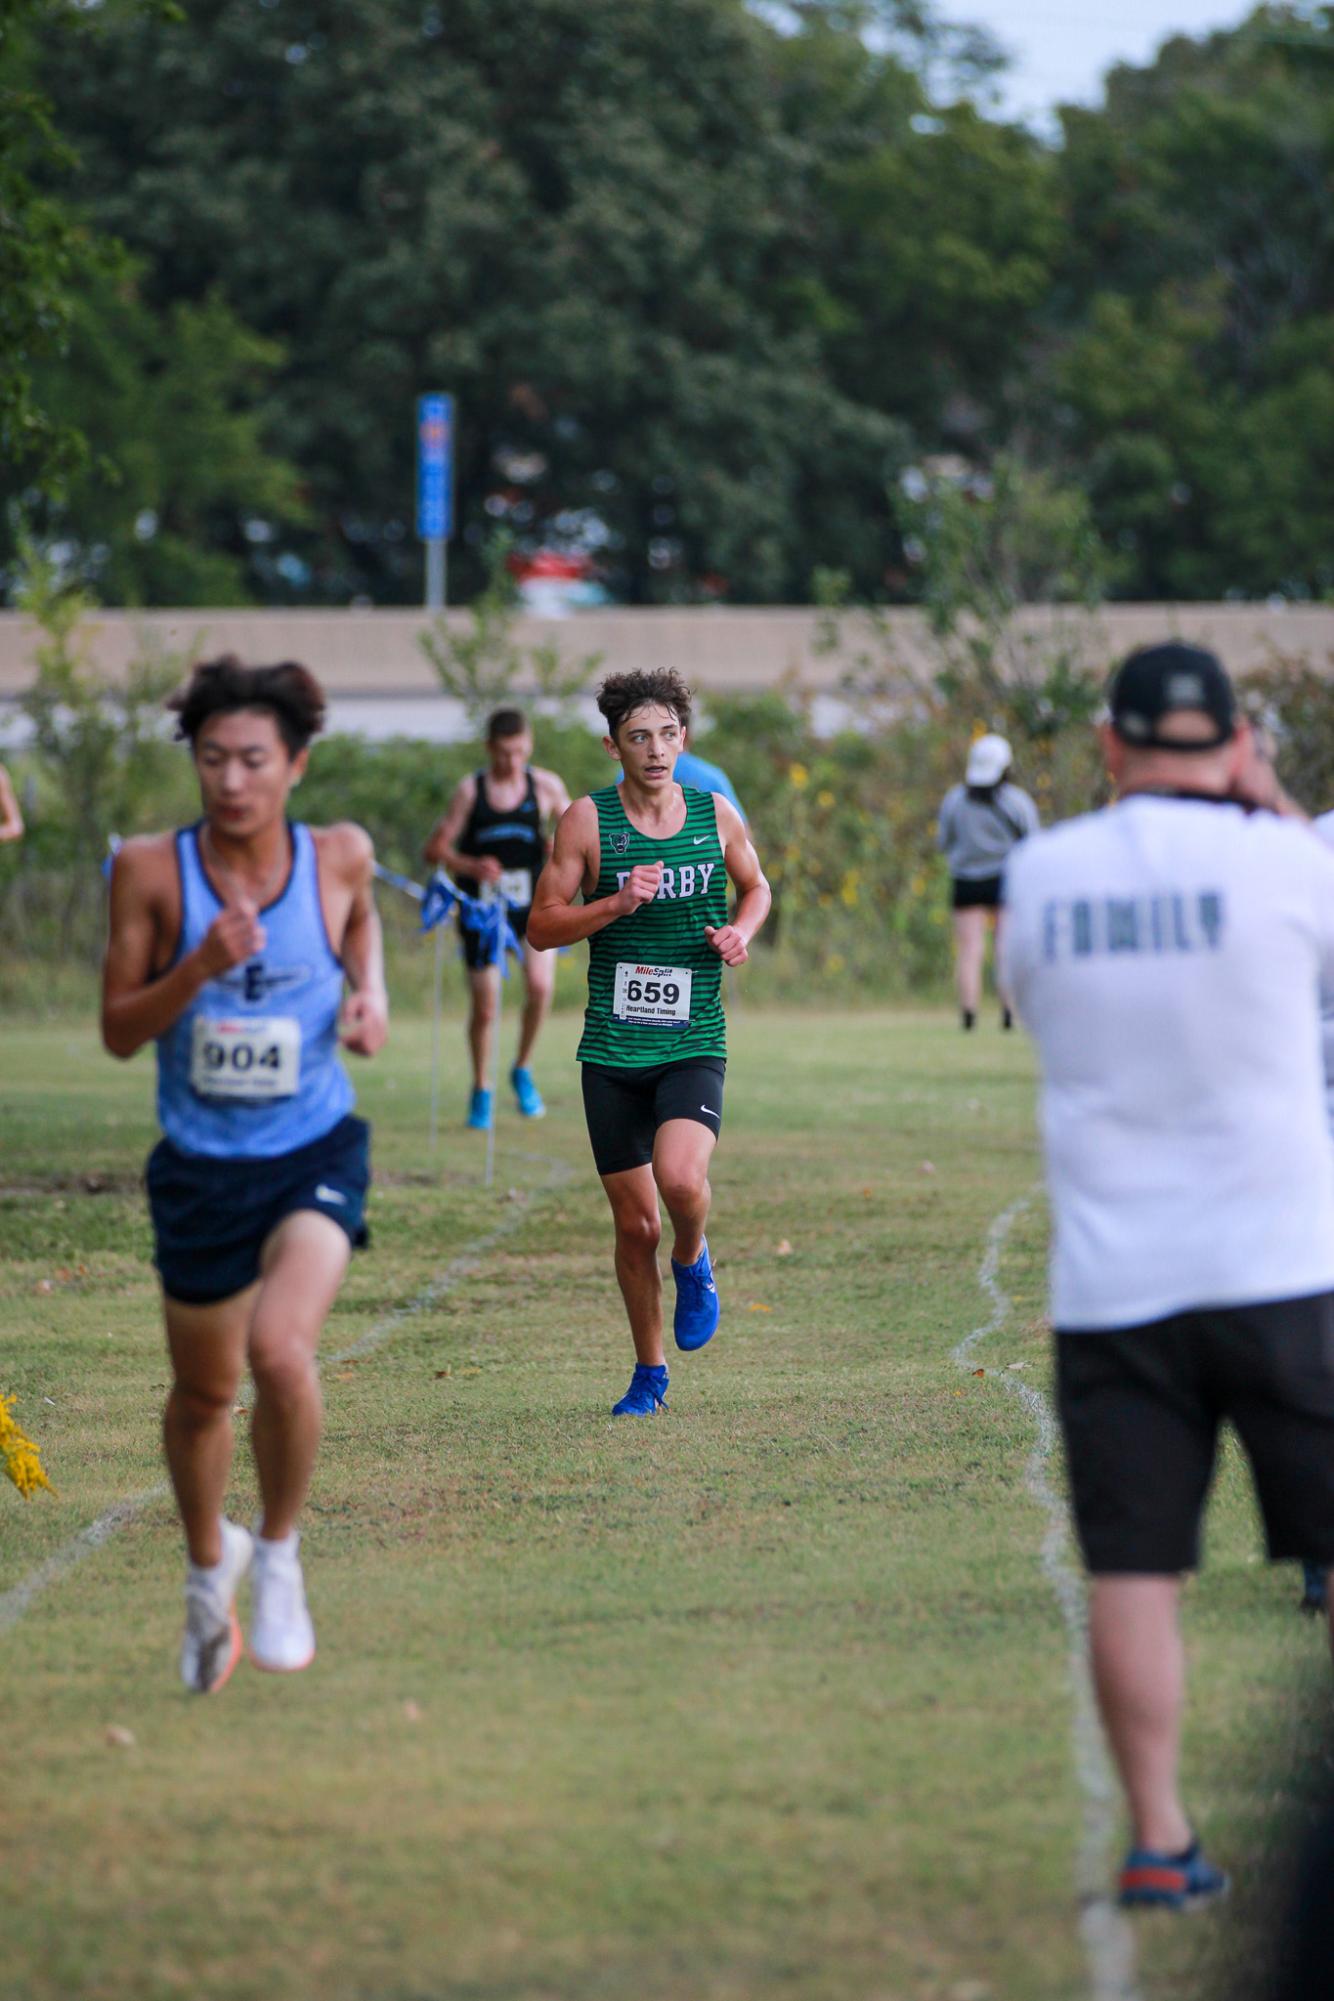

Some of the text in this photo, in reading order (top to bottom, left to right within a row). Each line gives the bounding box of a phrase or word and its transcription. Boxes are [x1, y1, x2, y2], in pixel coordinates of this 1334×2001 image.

[616, 863, 715, 899] RBY
[635, 966, 673, 977] MileSplit
[627, 980, 680, 1005] 659
[626, 1005, 676, 1016] Heartland Timing
[204, 1041, 281, 1071] 904
